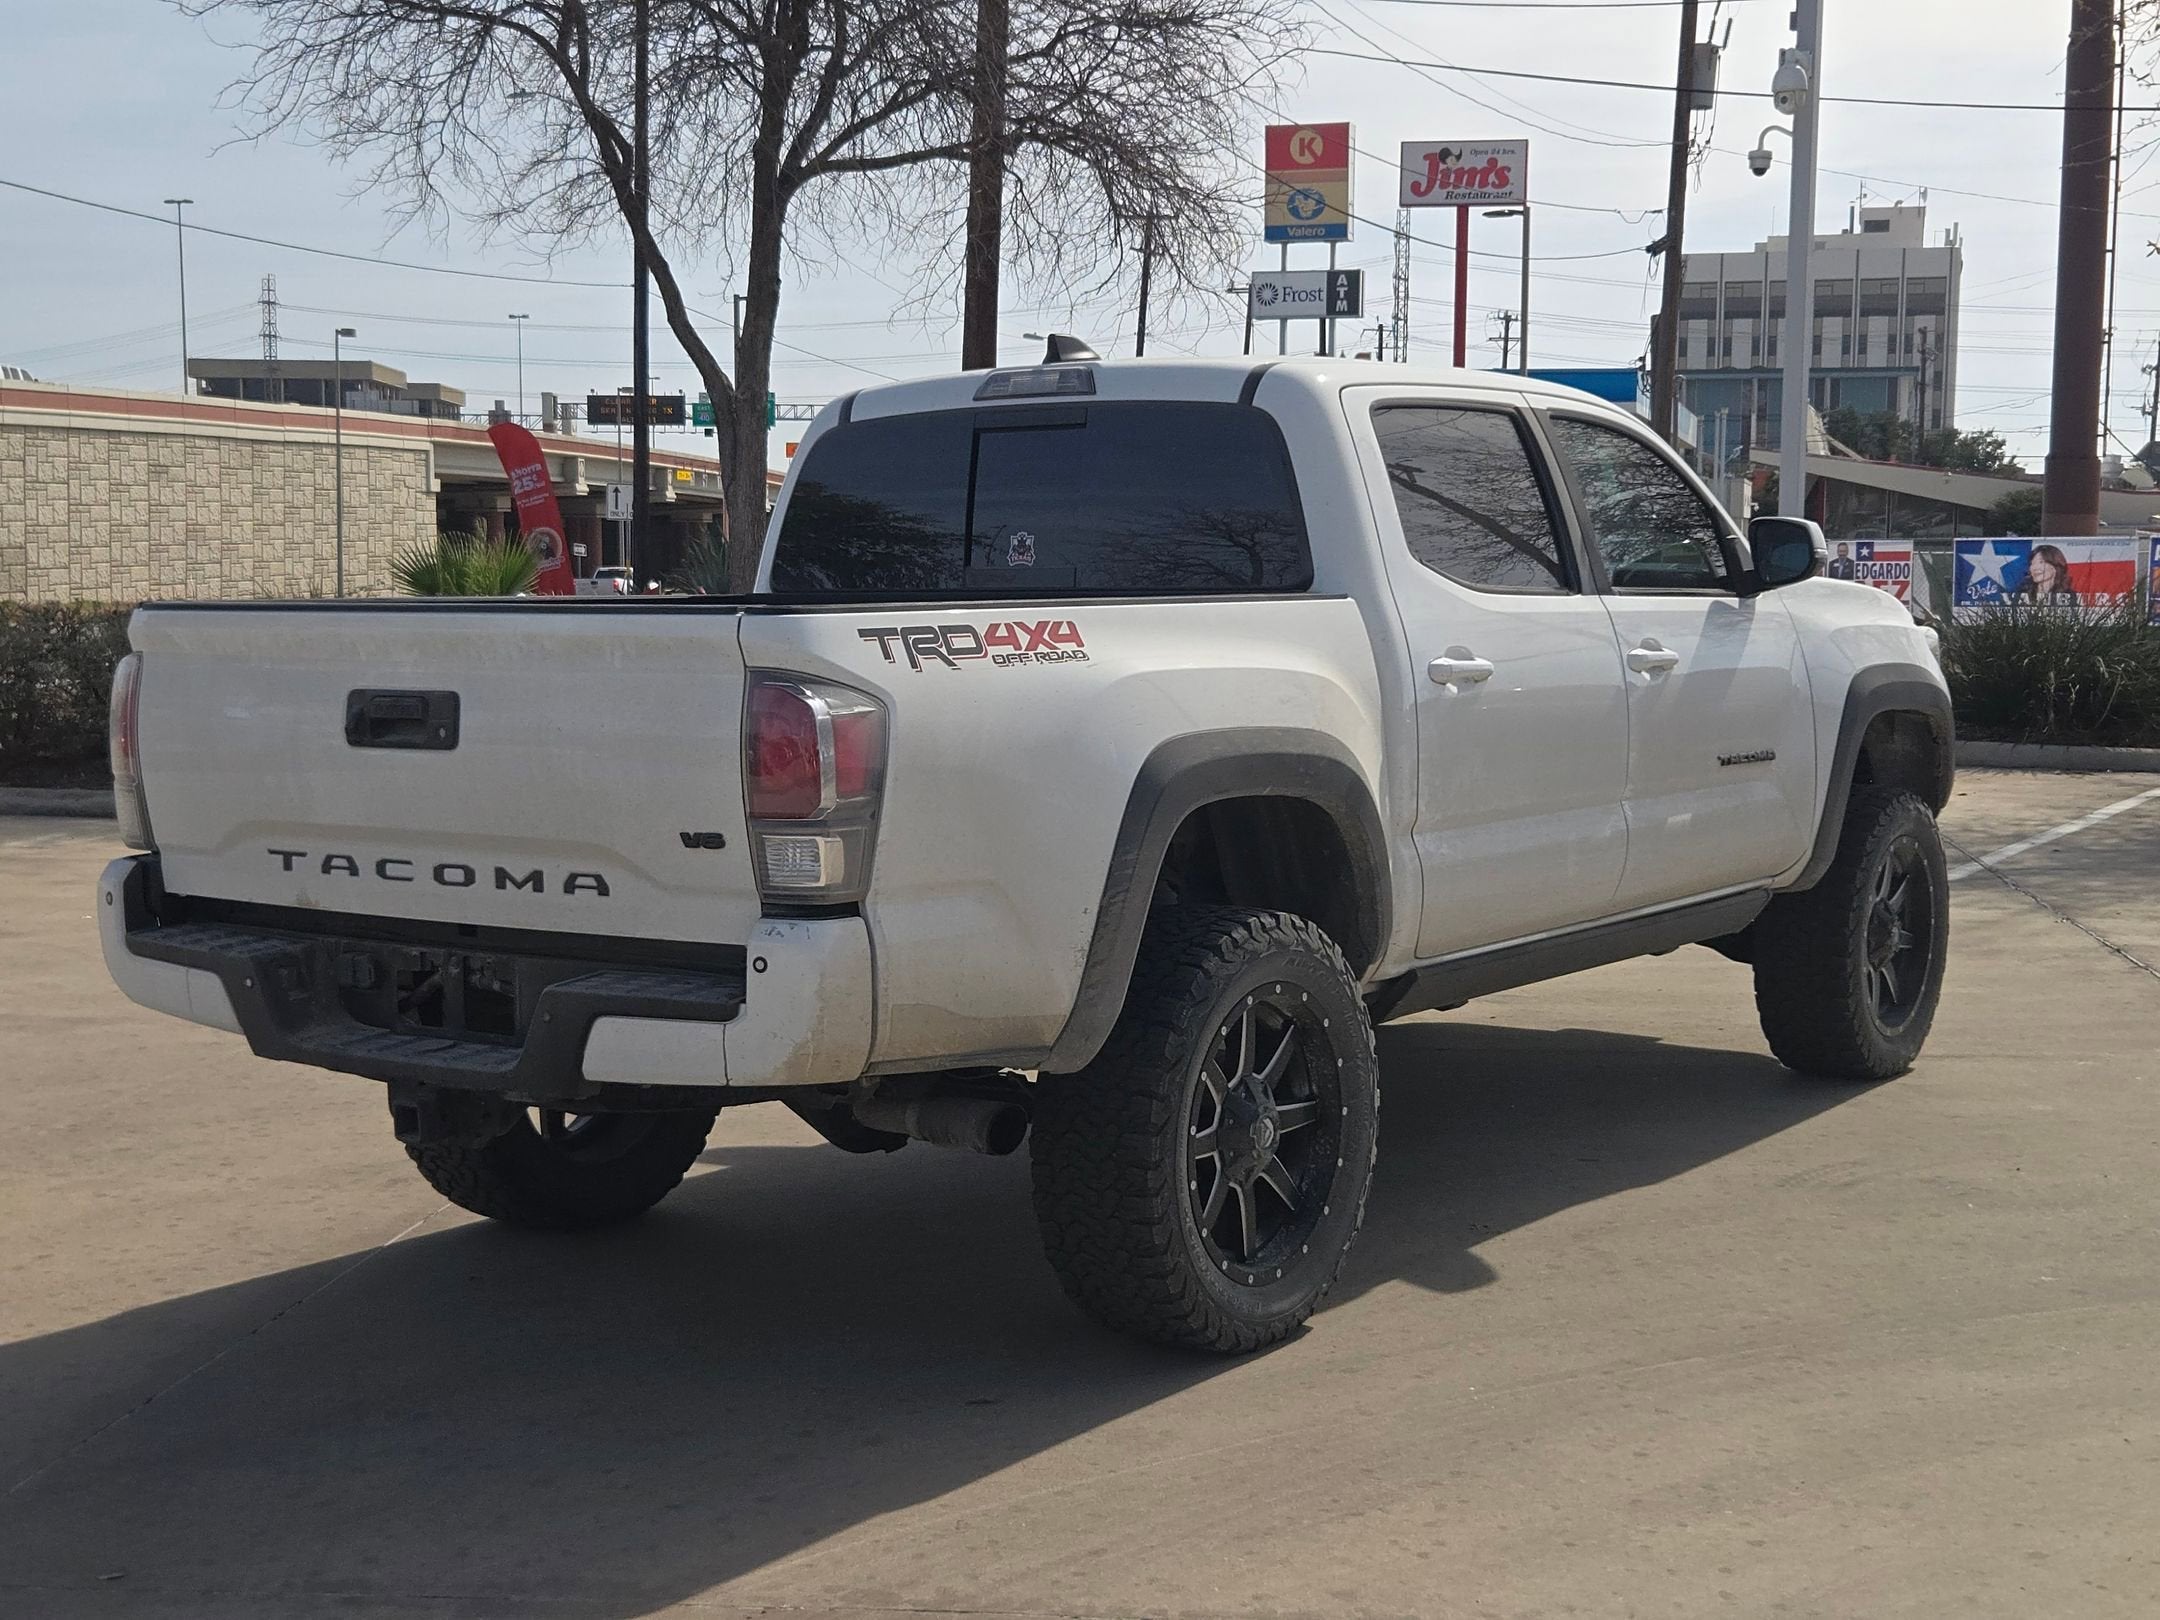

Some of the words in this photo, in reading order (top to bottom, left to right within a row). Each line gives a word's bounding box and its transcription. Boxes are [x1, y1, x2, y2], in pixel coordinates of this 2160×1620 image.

[1469, 148, 1489, 158] Open
[1410, 151, 1512, 198] Jim's
[1445, 190, 1513, 201] Restaurant
[1287, 226, 1326, 237] Valero
[1281, 286, 1324, 303] Frost
[1335, 273, 1349, 312] ATM
[1855, 562, 1911, 580] EDGARDO
[1966, 580, 1998, 600] Vote
[857, 624, 989, 673] TRD
[678, 831, 727, 850] V6
[267, 848, 611, 897] TACOMA
